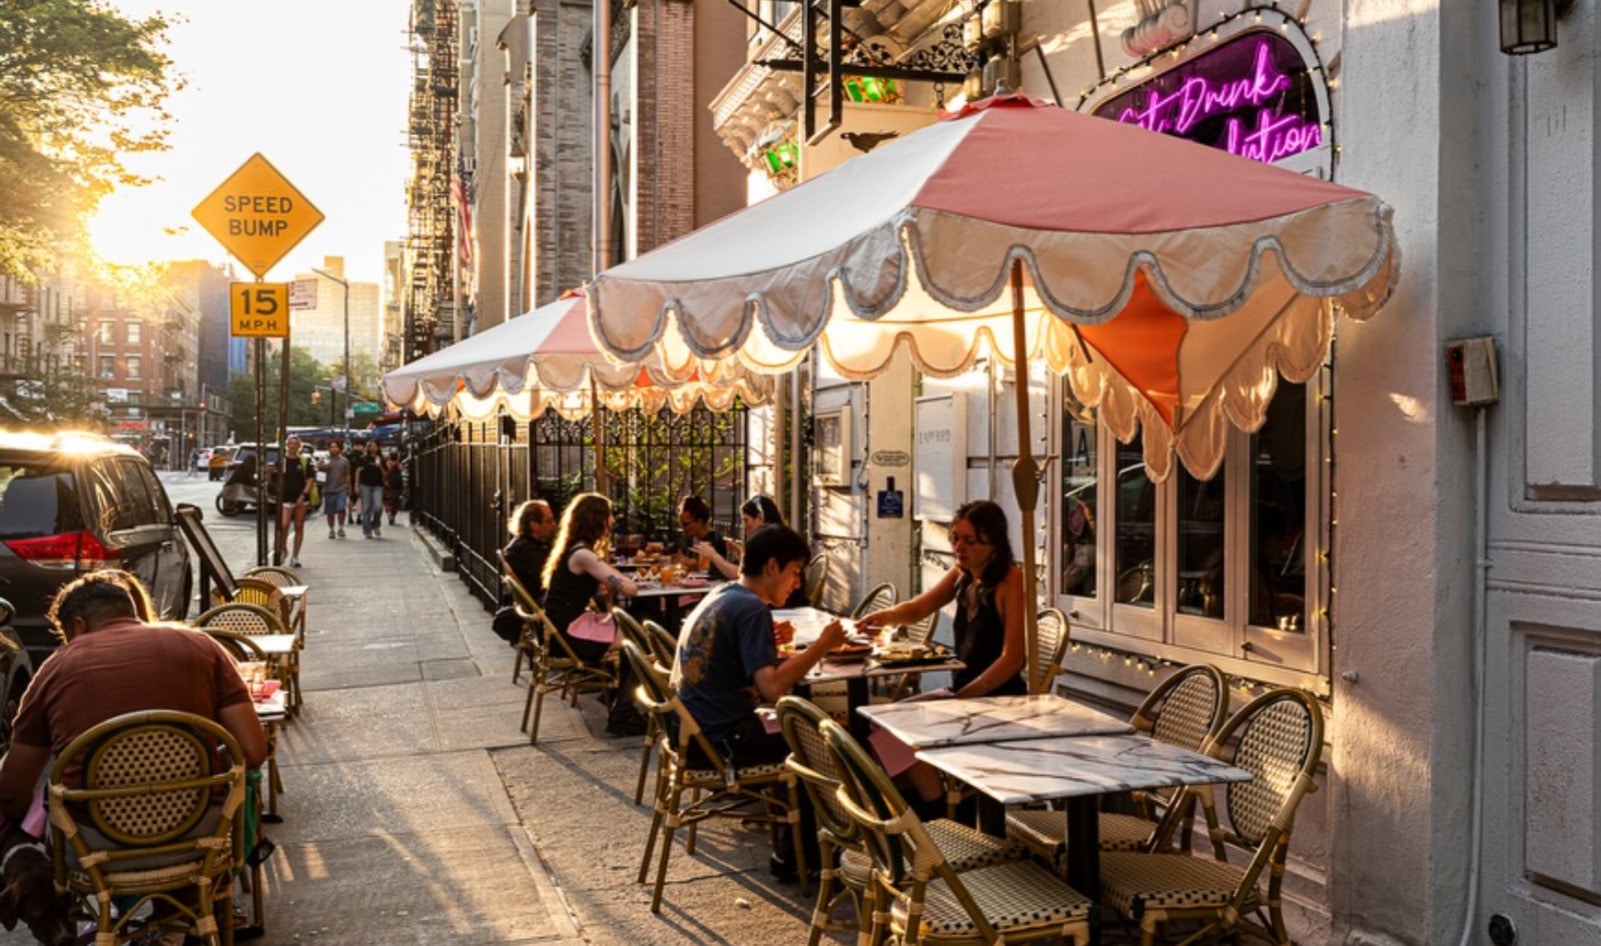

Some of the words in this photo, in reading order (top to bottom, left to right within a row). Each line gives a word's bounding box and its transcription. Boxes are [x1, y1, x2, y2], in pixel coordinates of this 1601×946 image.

[224, 195, 293, 214] SPEED
[229, 219, 289, 237] BUMP
[241, 289, 278, 316] 15
[1075, 428, 1091, 468] A
